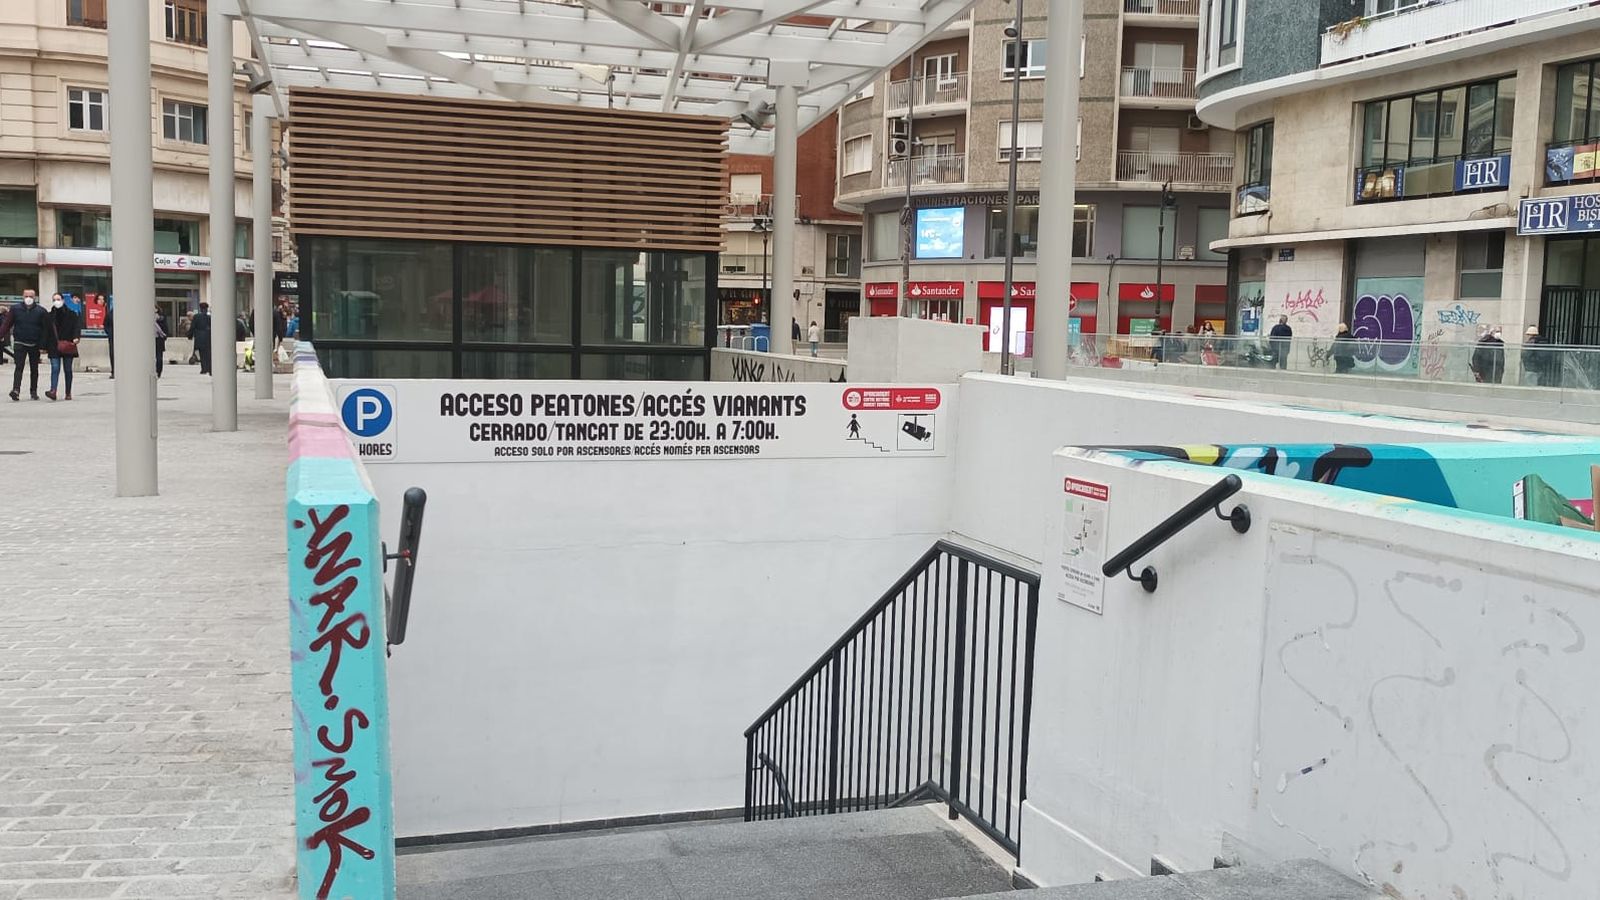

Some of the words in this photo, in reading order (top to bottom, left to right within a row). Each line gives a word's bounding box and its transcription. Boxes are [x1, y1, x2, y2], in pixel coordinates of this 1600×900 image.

[922, 284, 960, 295] Santander
[357, 396, 383, 431] P
[440, 393, 523, 417] ACCESO
[713, 395, 807, 417] VIANANTS
[469, 420, 619, 441] CERRADO/TANCAT
[624, 422, 644, 441] DE
[649, 420, 710, 441] 23:00H.
[716, 422, 727, 440] A
[732, 420, 779, 440] 7:00H.
[359, 443, 392, 456] HORES
[494, 446, 529, 457] ACCESO
[531, 446, 554, 456] SOLO
[556, 446, 574, 456] POR
[663, 442, 693, 455] NOMÉS
[695, 445, 711, 455] PER
[713, 445, 760, 455] ASCENSORS
